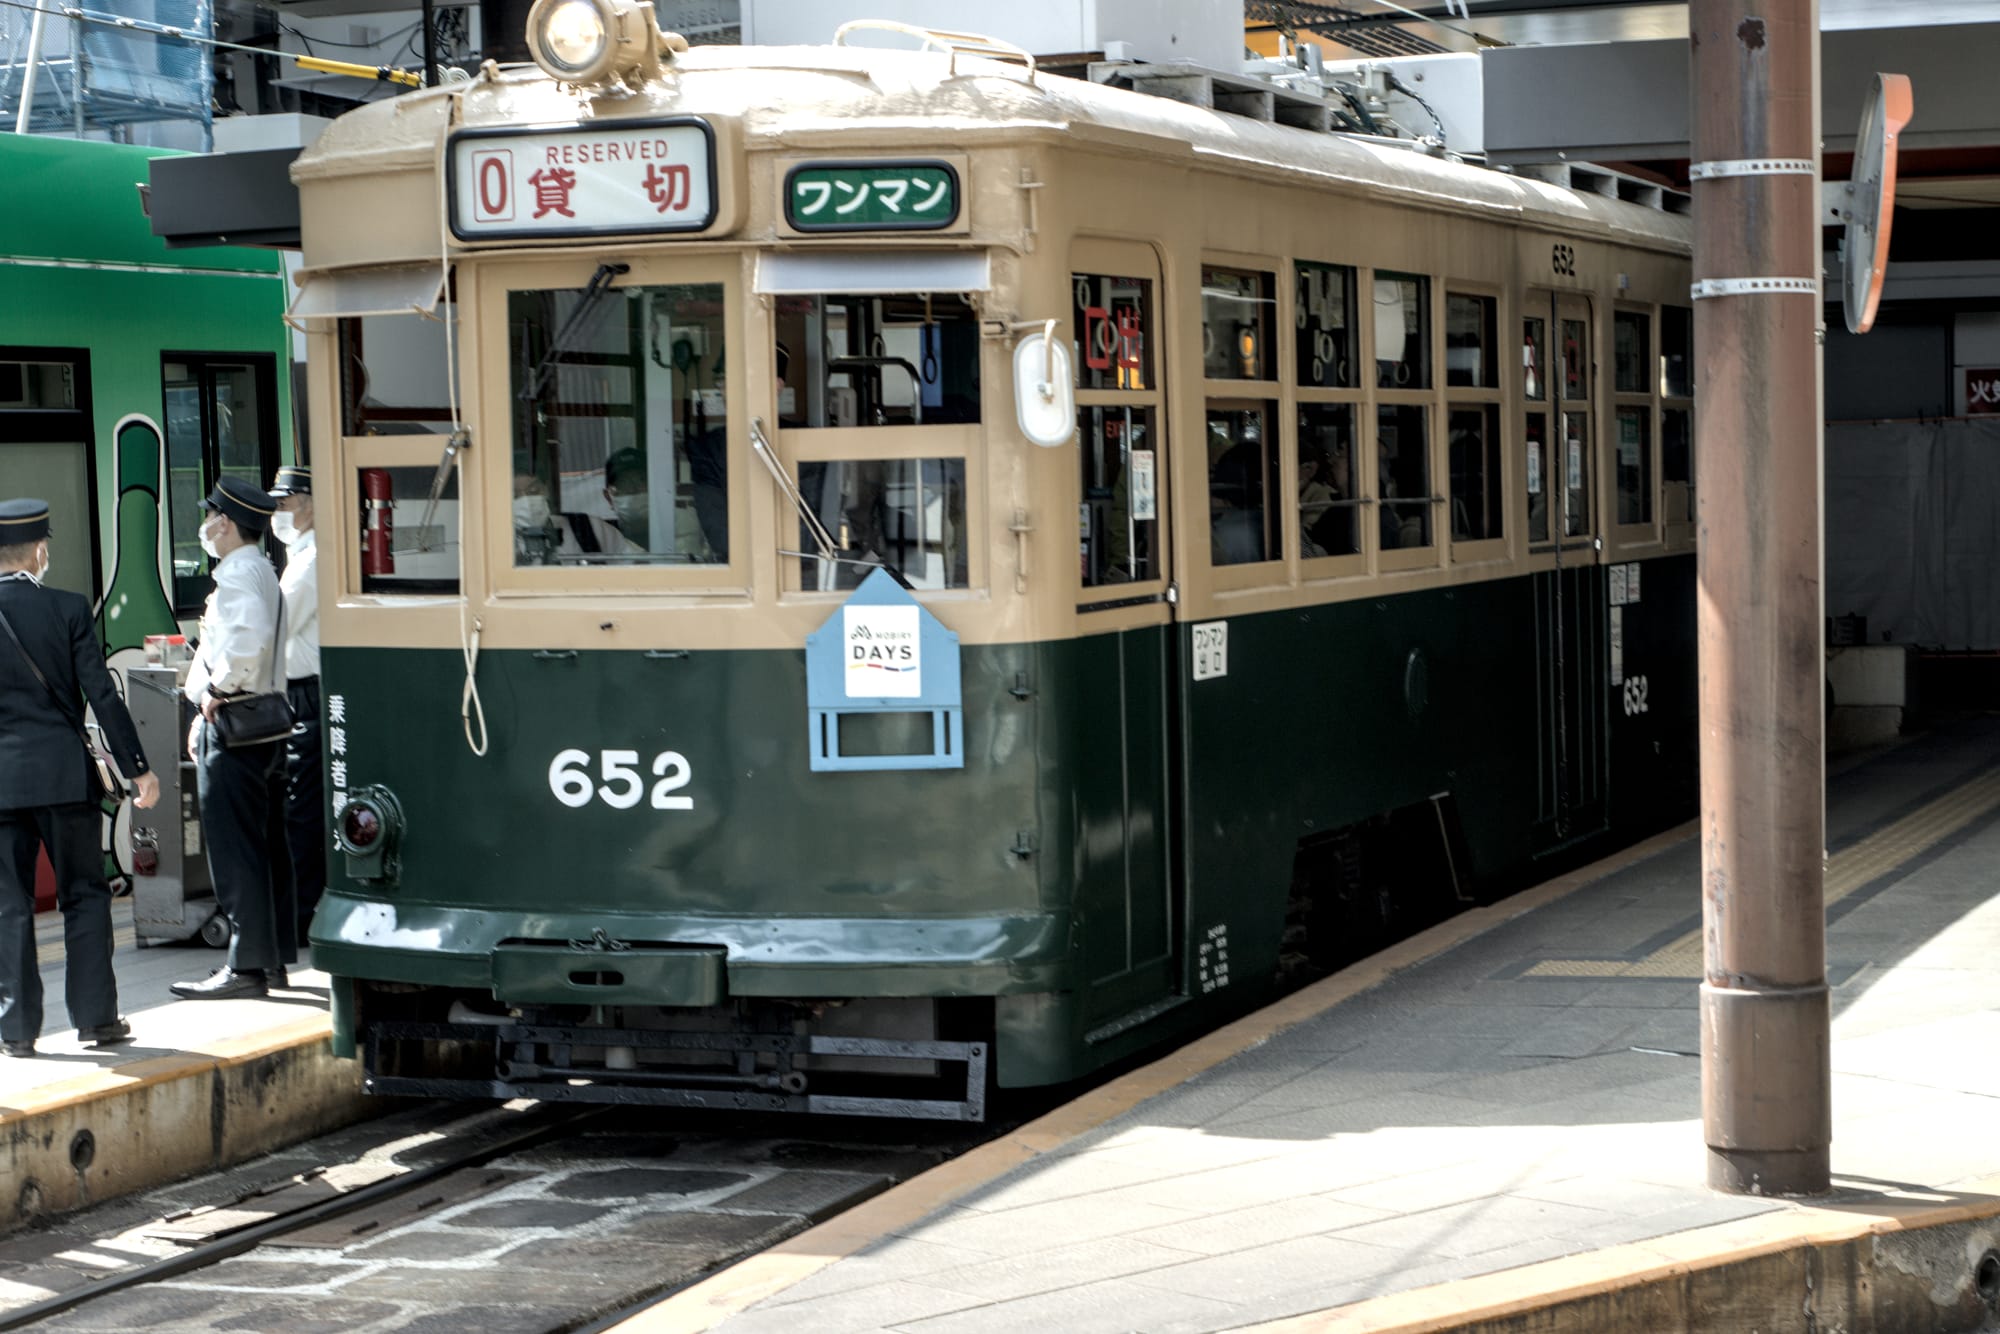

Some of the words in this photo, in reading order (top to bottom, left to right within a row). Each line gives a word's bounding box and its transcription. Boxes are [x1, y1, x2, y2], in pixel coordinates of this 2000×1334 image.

[546, 139, 668, 164] RESERVED
[479, 157, 508, 215] 0
[527, 161, 691, 220] 貸切
[796, 178, 947, 216] ワンマン
[1552, 244, 1576, 277] 652
[853, 645, 912, 660] DAYS
[1195, 628, 1225, 650] ワンマン
[1623, 674, 1649, 717] 652
[548, 748, 693, 811] 652
